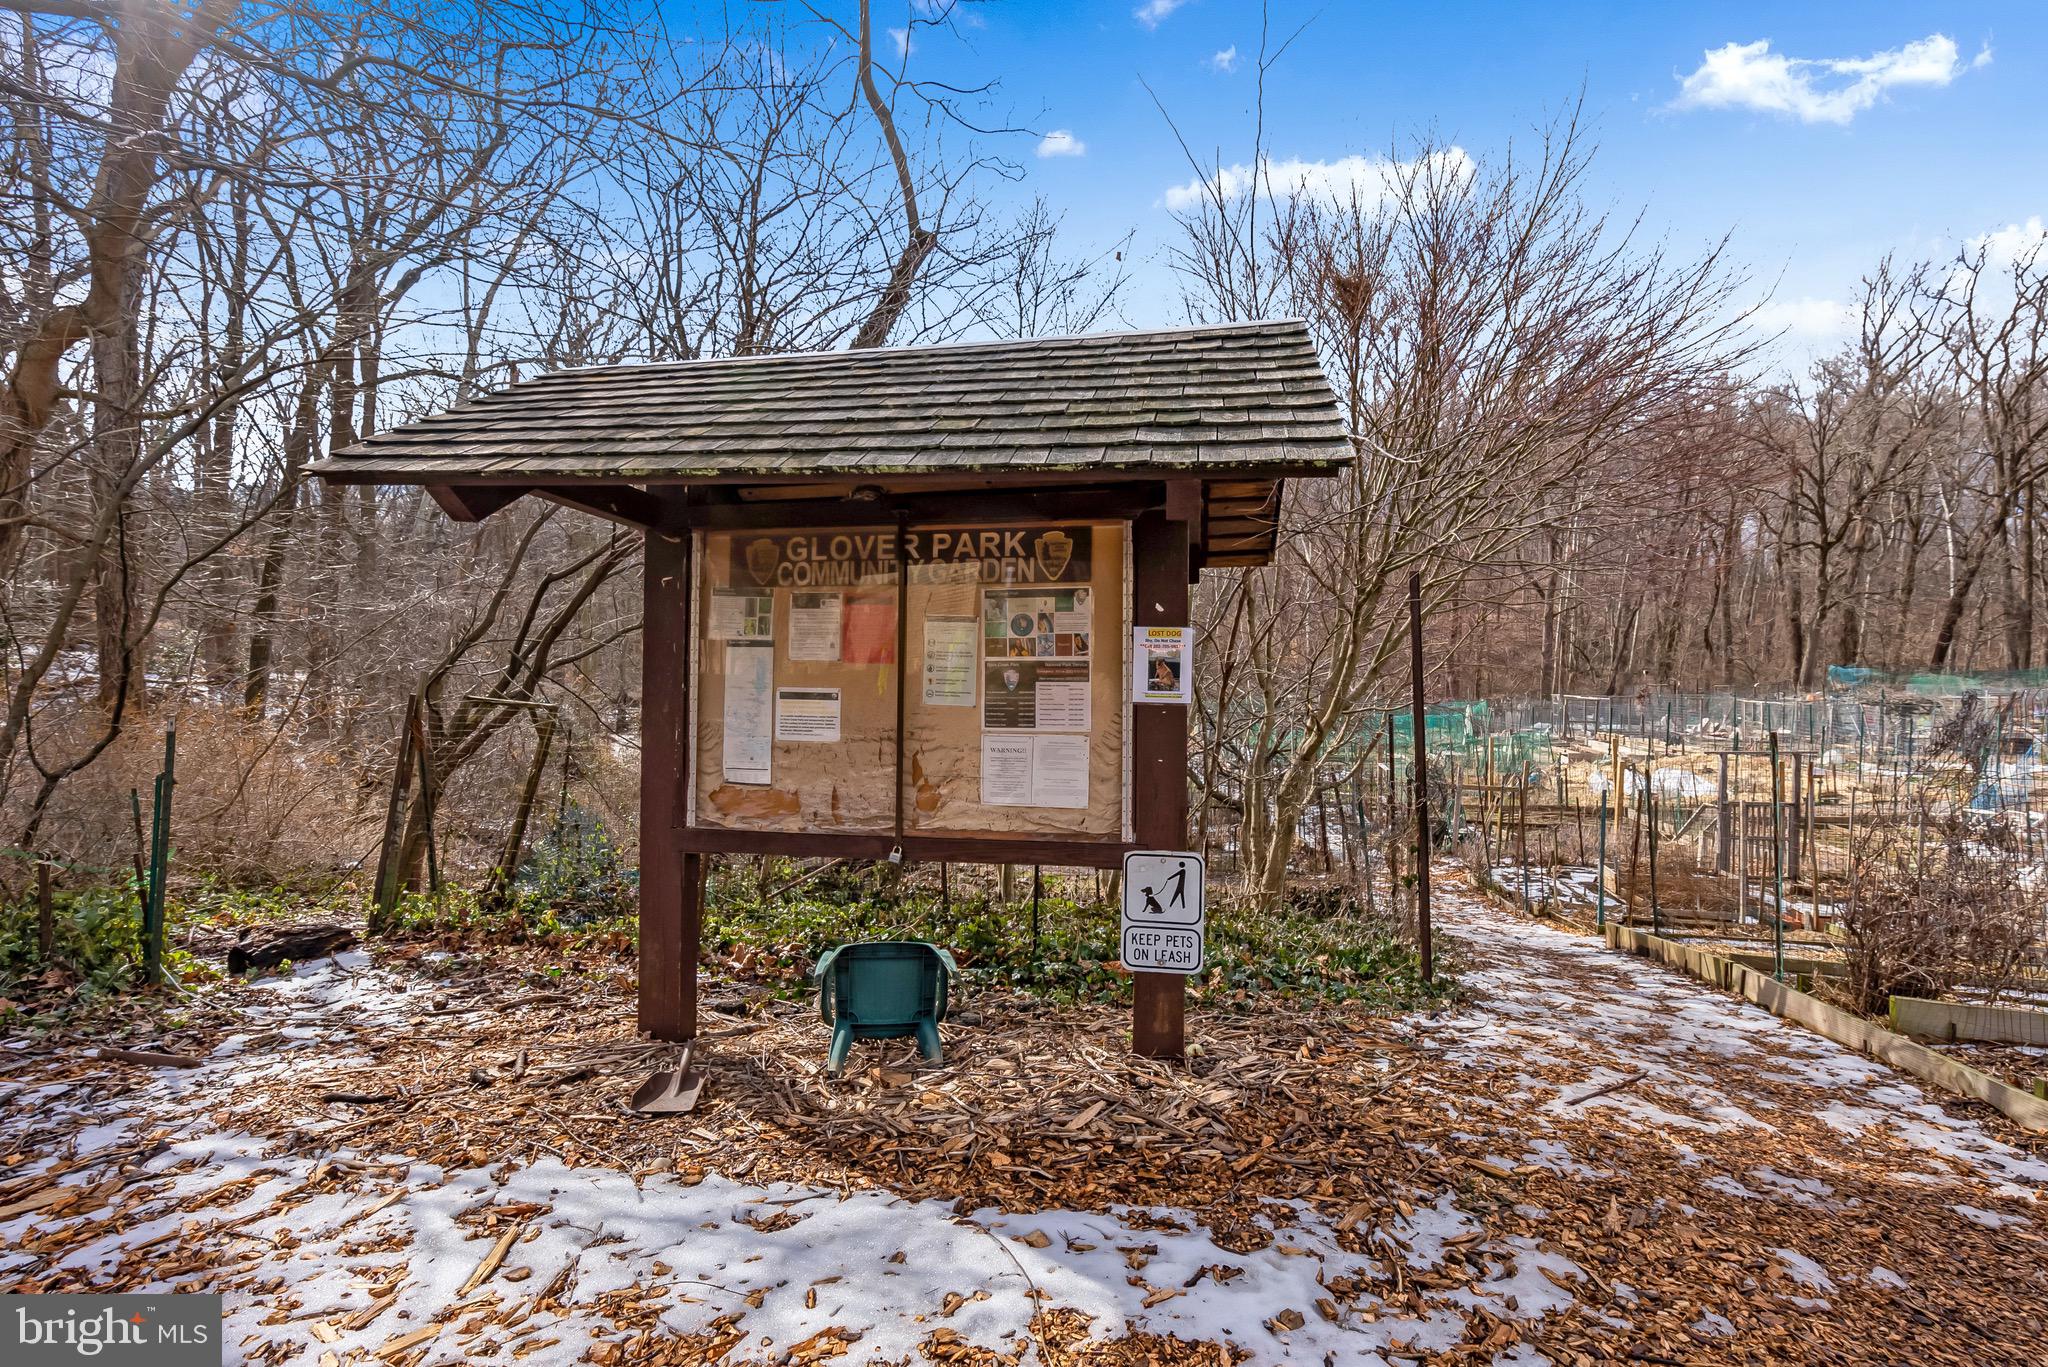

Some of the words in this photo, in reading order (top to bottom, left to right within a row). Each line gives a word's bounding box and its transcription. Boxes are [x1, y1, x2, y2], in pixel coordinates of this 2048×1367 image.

[787, 534, 919, 561] GLOVER
[933, 531, 1026, 557] PARK
[777, 559, 925, 586] COMMUNITY
[928, 557, 1035, 583] GARDEN
[1131, 933, 1161, 946] KEEP
[1166, 935, 1193, 948] PETS
[1133, 948, 1149, 961] ON
[1154, 949, 1191, 963] LEASH
